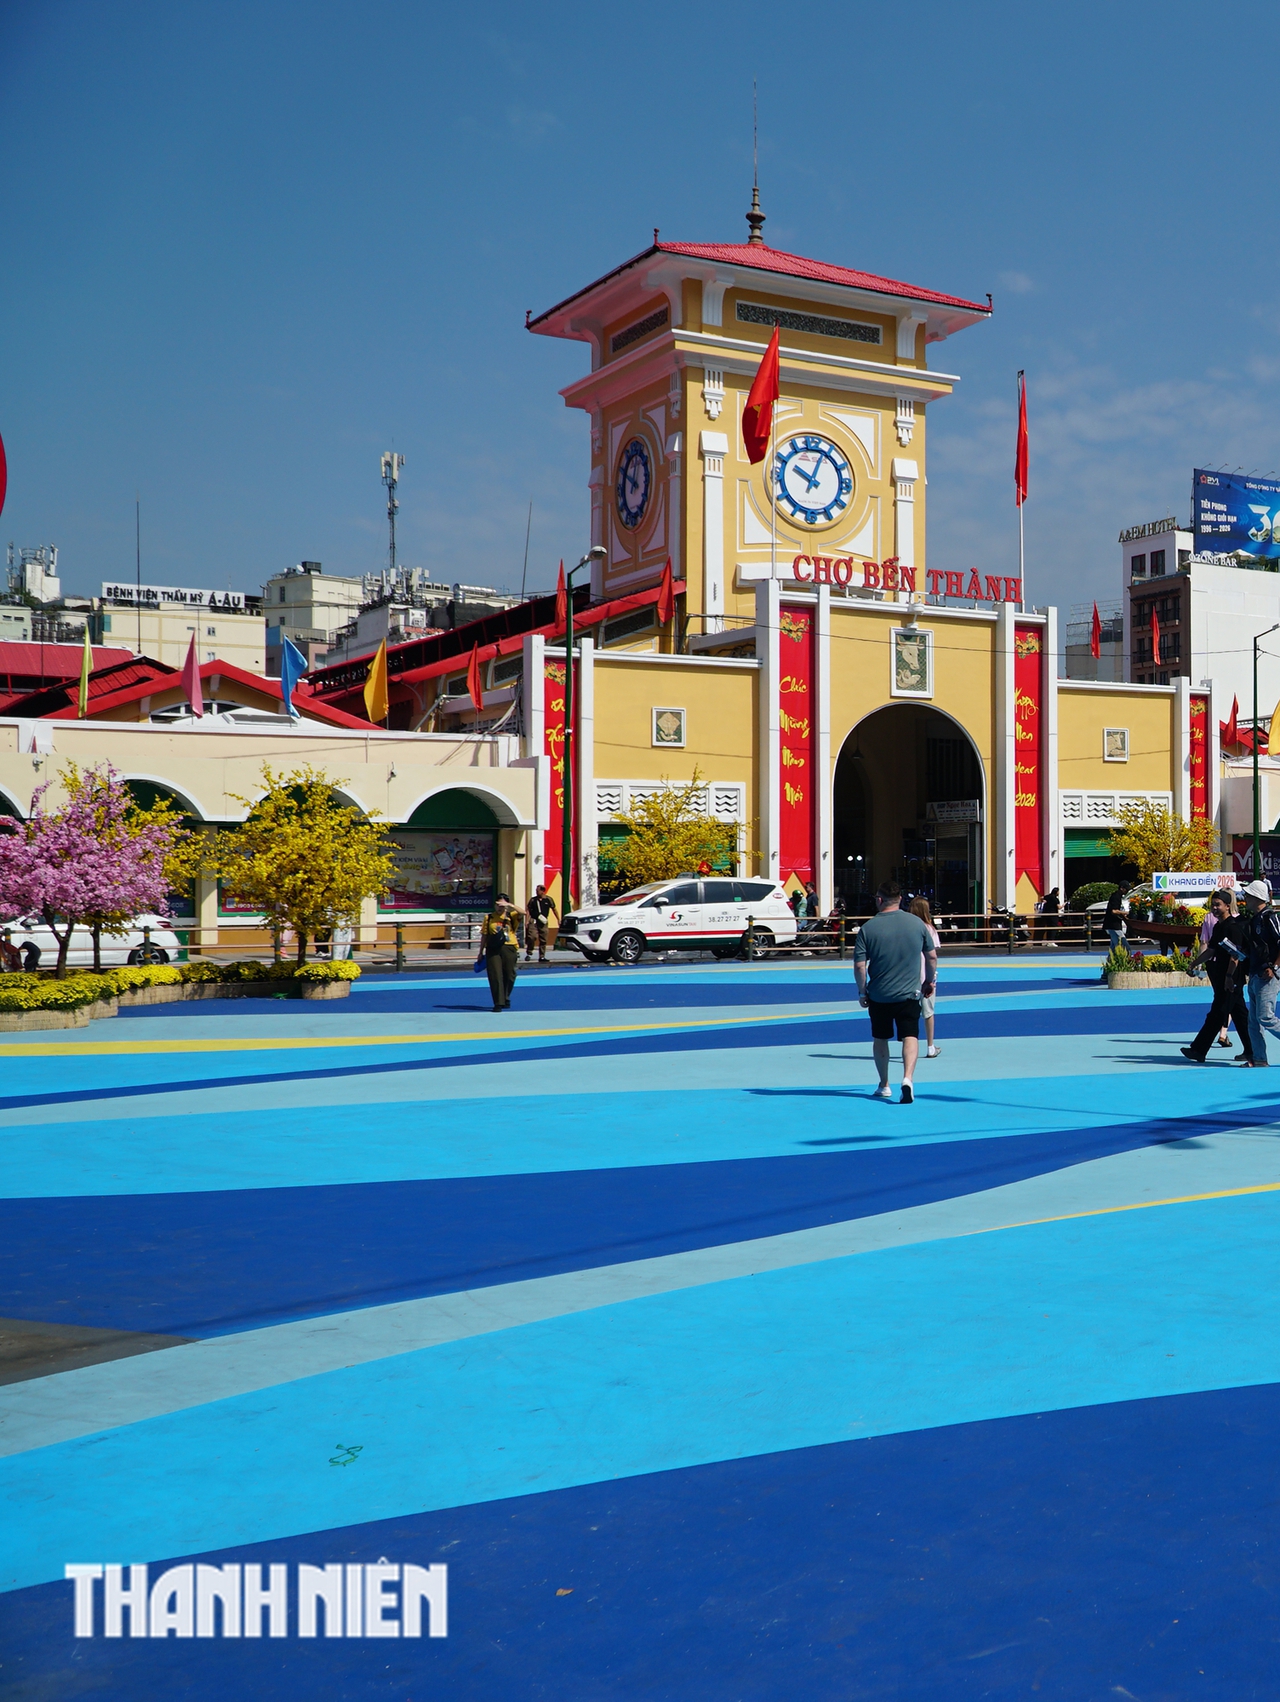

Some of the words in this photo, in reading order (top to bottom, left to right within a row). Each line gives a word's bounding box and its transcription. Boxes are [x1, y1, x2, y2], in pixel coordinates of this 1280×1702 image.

[1147, 517, 1177, 537] HOTEL
[1188, 552, 1220, 566] OZONE
[1219, 557, 1238, 568] BAR
[793, 554, 853, 590] CHỢ
[862, 556, 918, 593] BẾN
[927, 566, 1023, 603] THÀNH
[106, 585, 133, 600] BỆNH
[136, 588, 158, 602] VIỆN
[161, 588, 187, 603] THẨM
[190, 592, 204, 604] MỸ
[208, 592, 241, 607] Á-ÂU
[779, 675, 808, 694] Chúc
[779, 708, 811, 739] Mừng
[782, 745, 805, 770] Năm
[784, 781, 804, 810] Mới
[1014, 793, 1036, 807] 2026
[1168, 878, 1197, 886] KHANG
[1217, 875, 1235, 888] 2026
